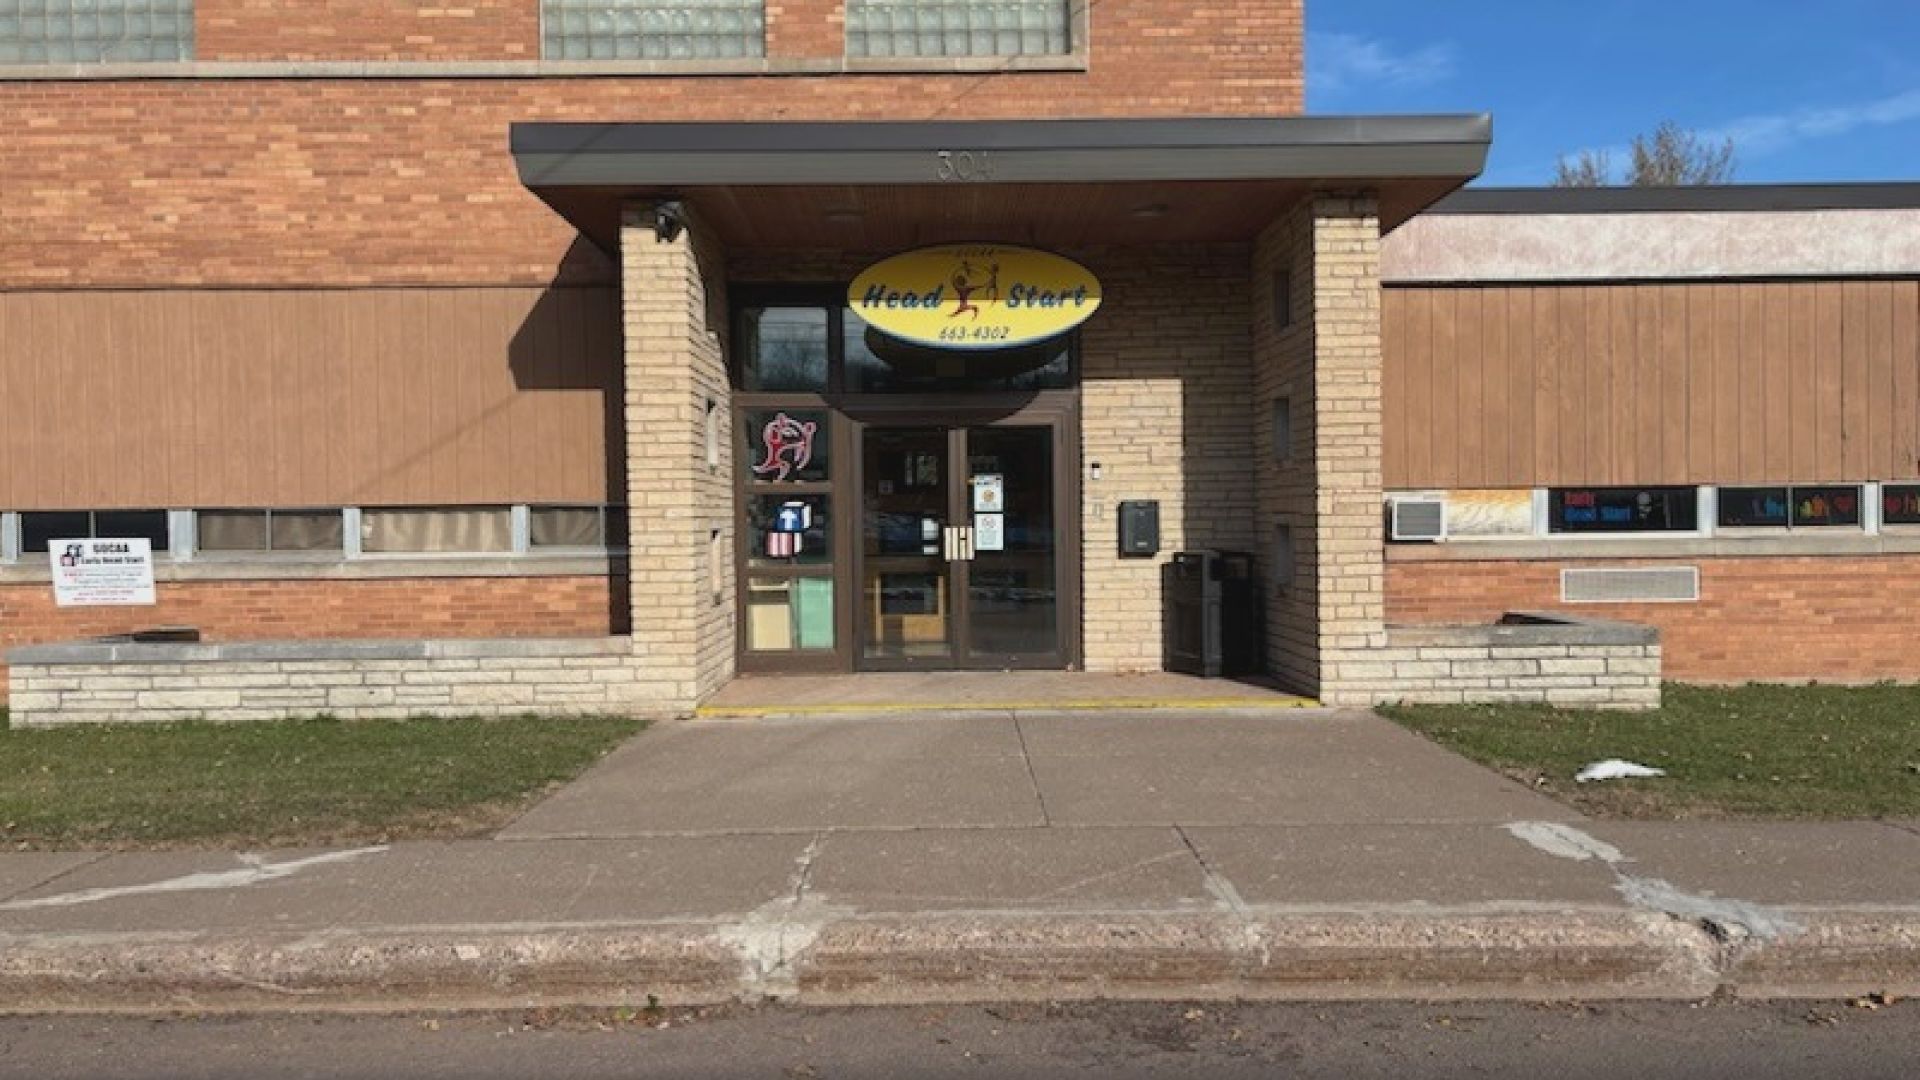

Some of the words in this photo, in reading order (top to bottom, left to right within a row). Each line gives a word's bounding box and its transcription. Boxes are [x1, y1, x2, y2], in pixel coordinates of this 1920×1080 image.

[863, 283, 944, 309] Head
[1006, 281, 1088, 309] Start
[938, 325, 1011, 341] 663-4302
